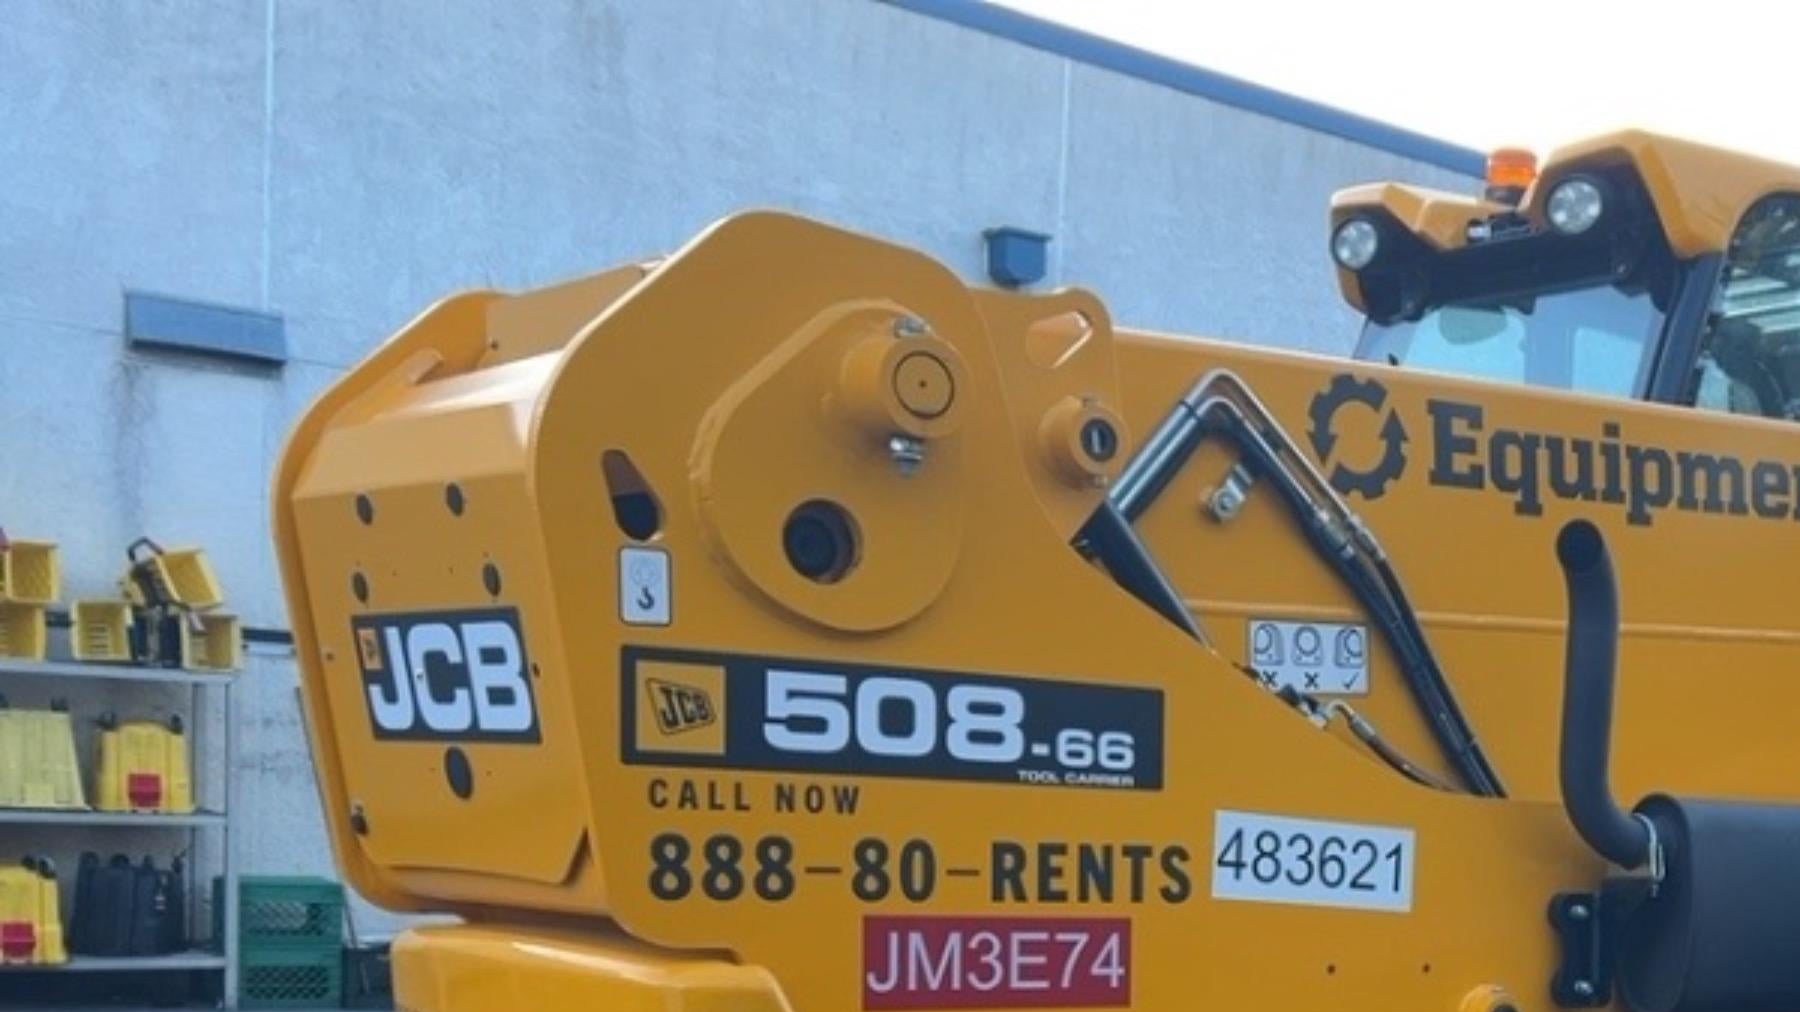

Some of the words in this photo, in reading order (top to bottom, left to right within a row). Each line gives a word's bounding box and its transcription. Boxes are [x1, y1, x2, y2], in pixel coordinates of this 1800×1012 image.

[368, 621, 532, 731] JCB
[658, 686, 709, 728] JCB
[763, 671, 1135, 768] 508-66
[648, 778, 750, 813] CALL
[774, 783, 861, 815] NOW
[1017, 769, 1060, 784] TOOL
[1064, 771, 1135, 787] CARRIER
[648, 832, 1191, 904] 888-80-RENTS
[1217, 828, 1403, 892] 483621
[866, 930, 1126, 992] JM3E74
